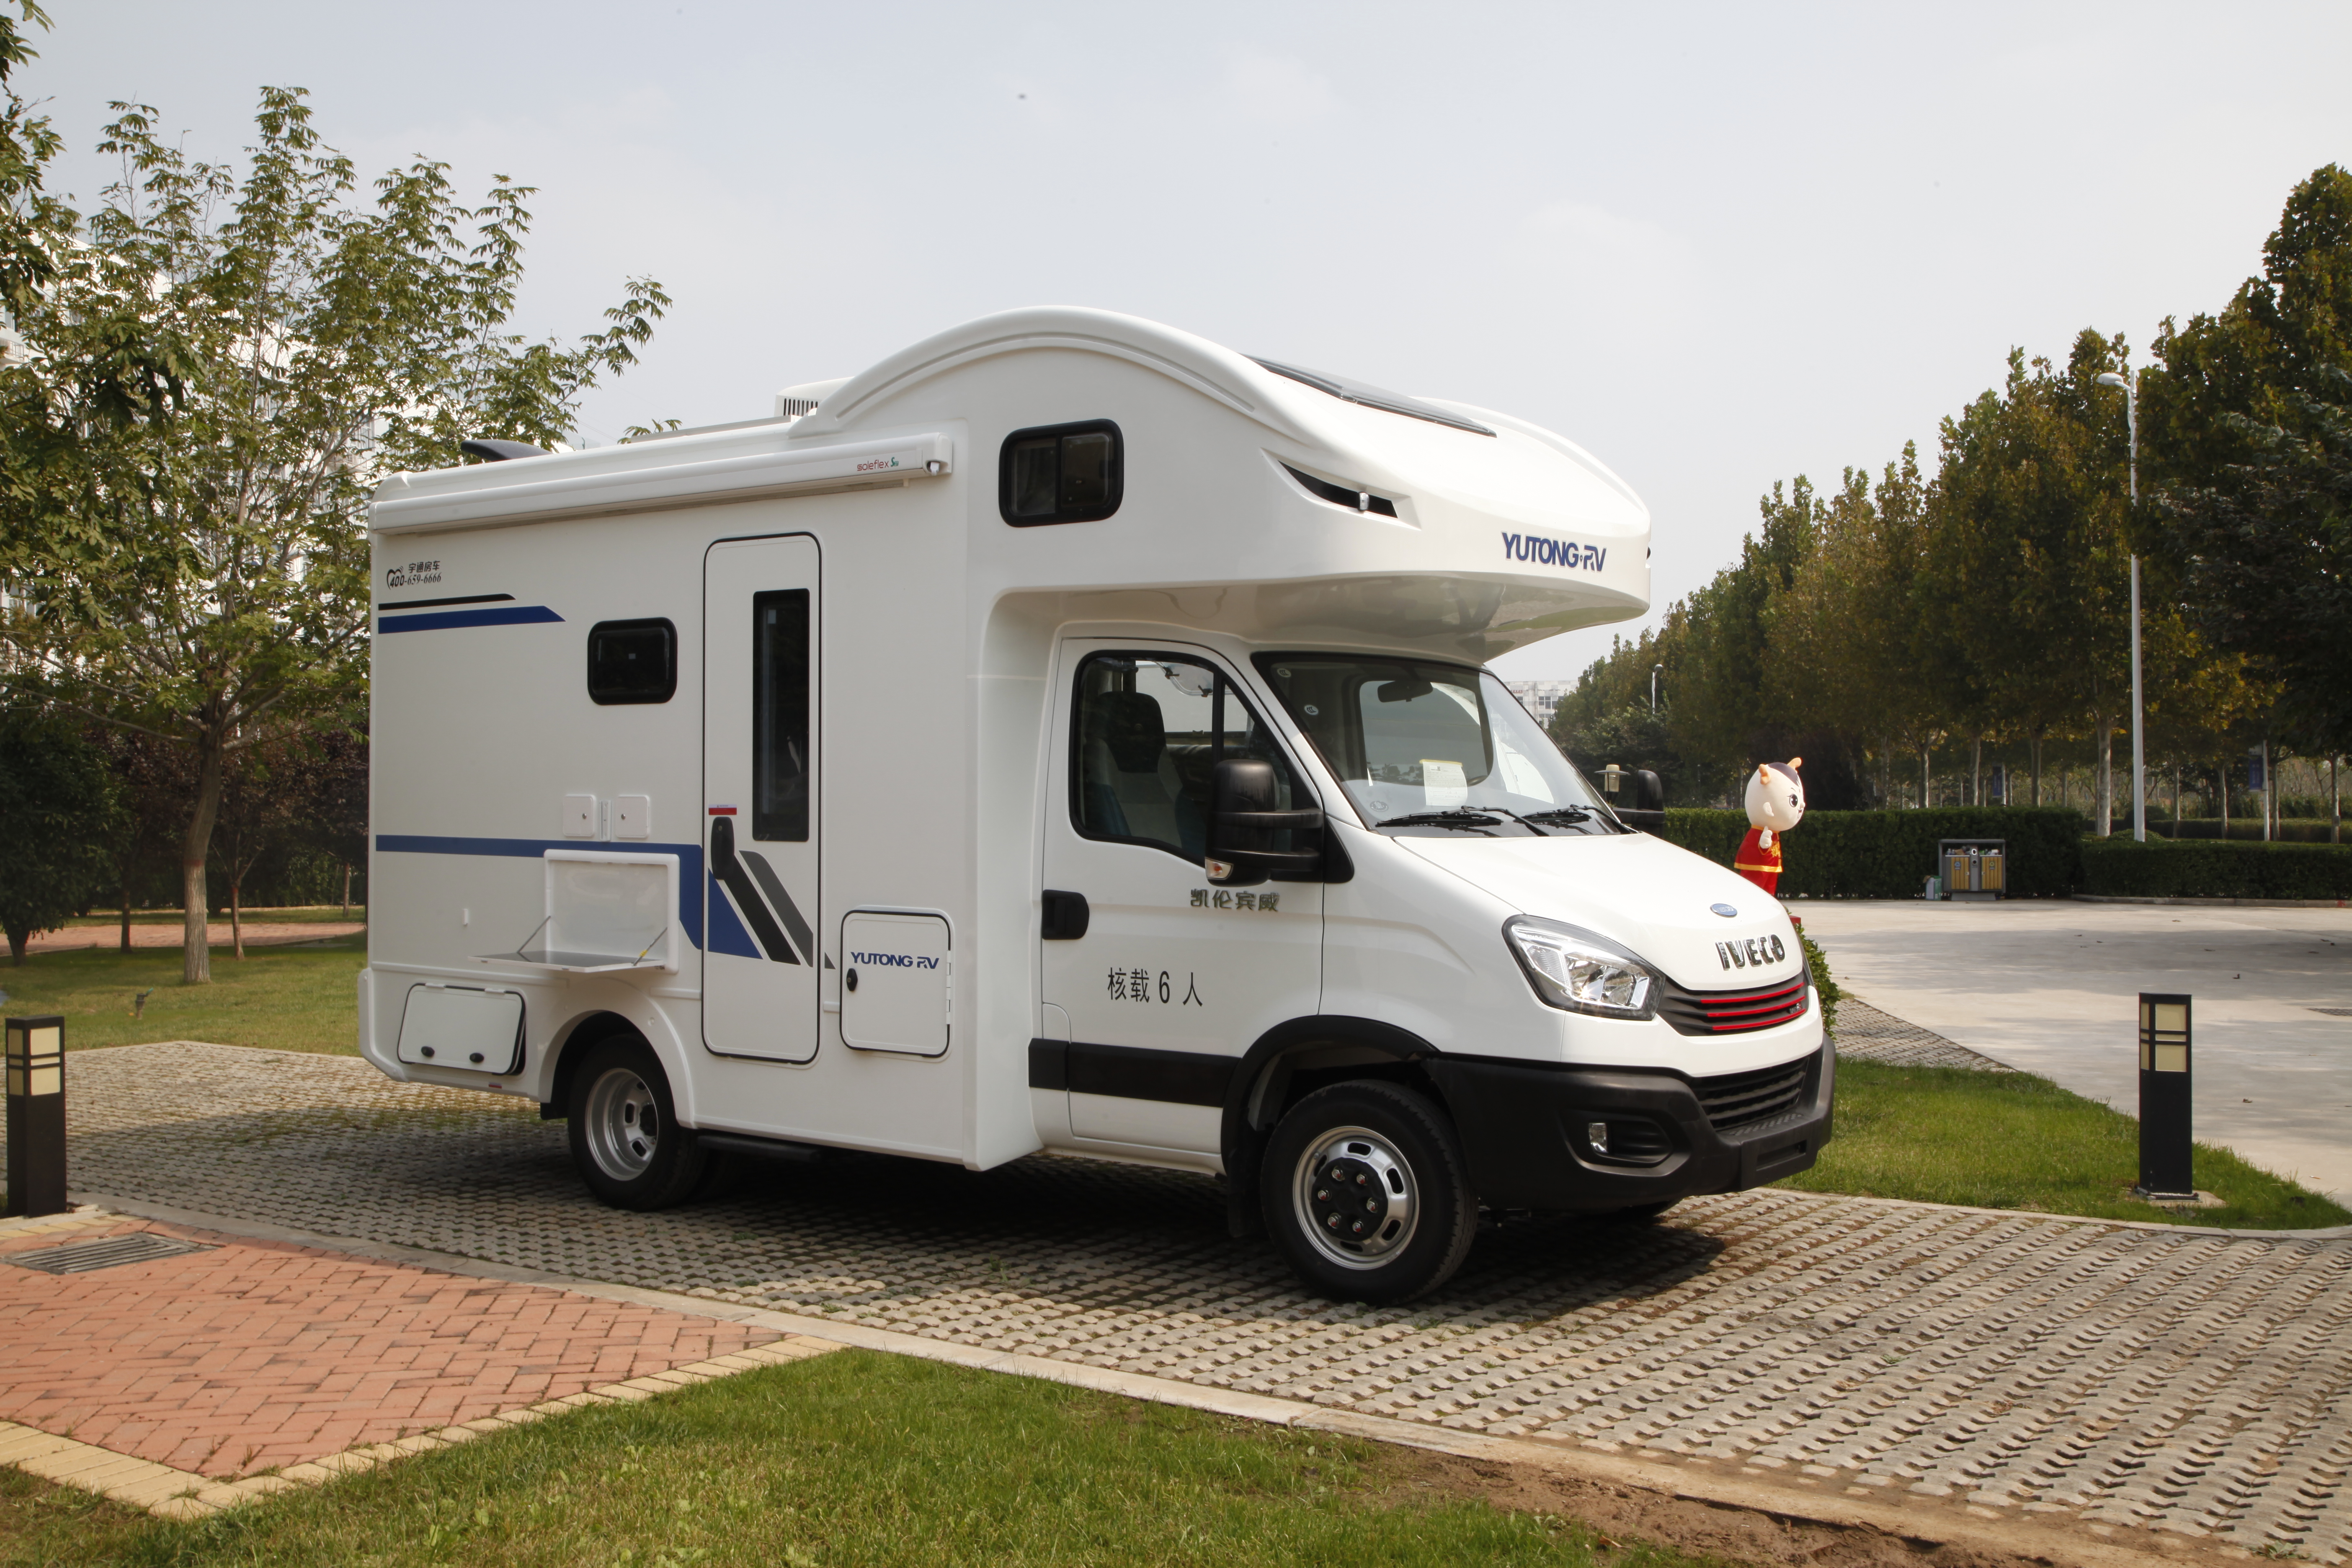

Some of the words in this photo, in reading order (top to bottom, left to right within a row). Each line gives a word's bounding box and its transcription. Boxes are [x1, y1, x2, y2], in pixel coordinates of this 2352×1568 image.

[857, 459, 889, 471] soleflex
[1502, 532, 1579, 568] YUTONG
[1583, 544, 1607, 572] RV
[408, 560, 441, 573] 宇通房车
[389, 572, 442, 588] 400-659-6666
[1190, 889, 1280, 912] 凯伦宾威
[850, 952, 913, 967] YUTONG
[917, 956, 940, 970] RV
[1715, 934, 1785, 971] IVECO
